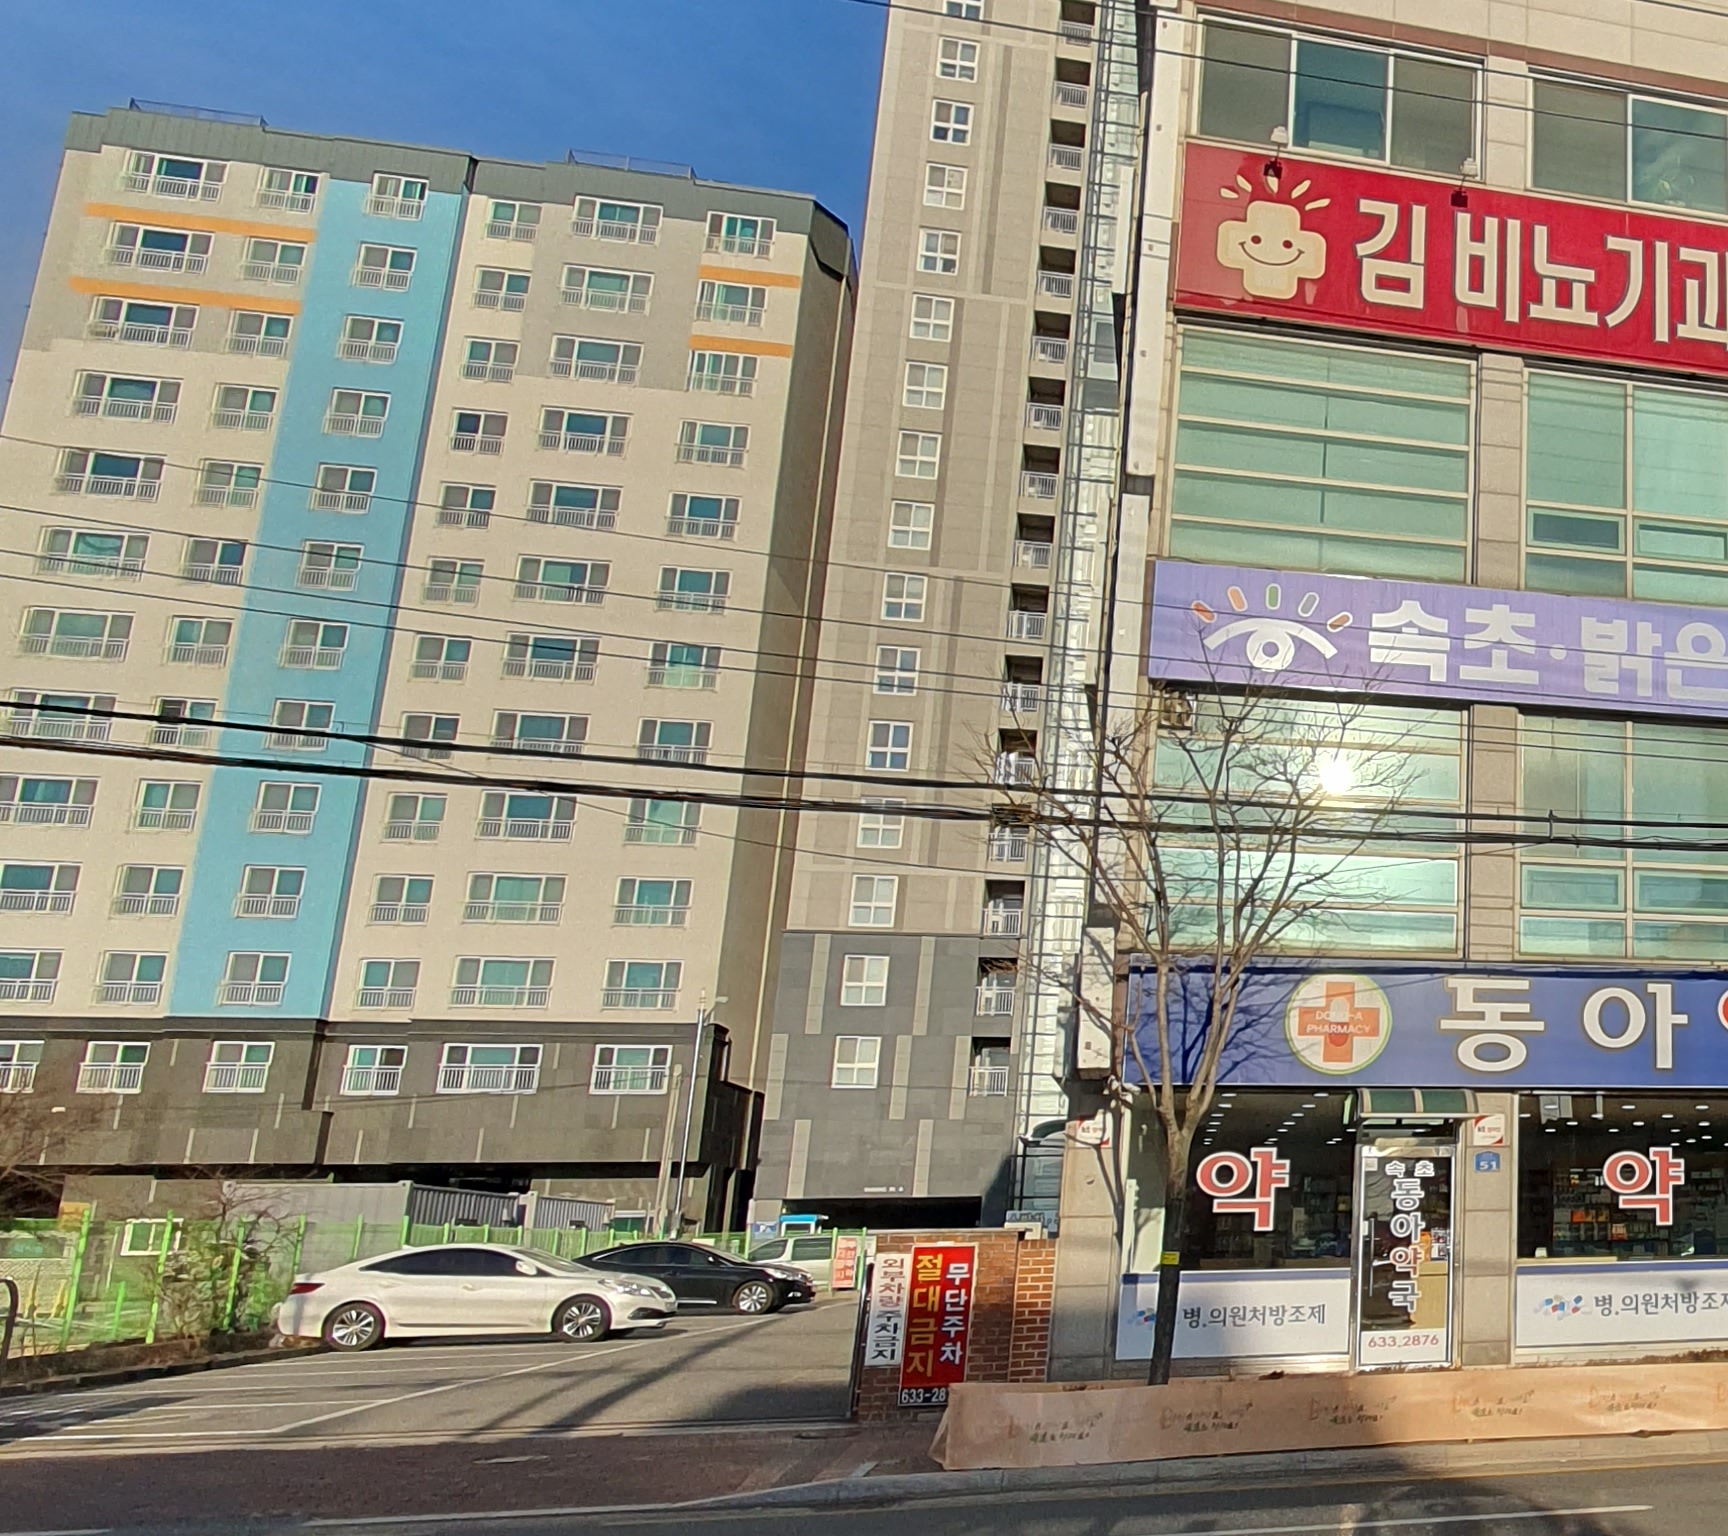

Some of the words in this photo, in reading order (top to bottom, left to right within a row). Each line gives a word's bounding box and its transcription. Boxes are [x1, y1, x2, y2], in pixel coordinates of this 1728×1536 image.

[1306, 1024, 1371, 1034] PHARMACY
[1315, 1010, 1363, 1020] DO-A
[1197, 1147, 1290, 1232] 약
[1602, 1146, 1685, 1226] 약
[1389, 1178, 1425, 1313] 동아약국
[906, 1254, 943, 1377] 절대금지
[939, 1262, 970, 1364] 무단주차
